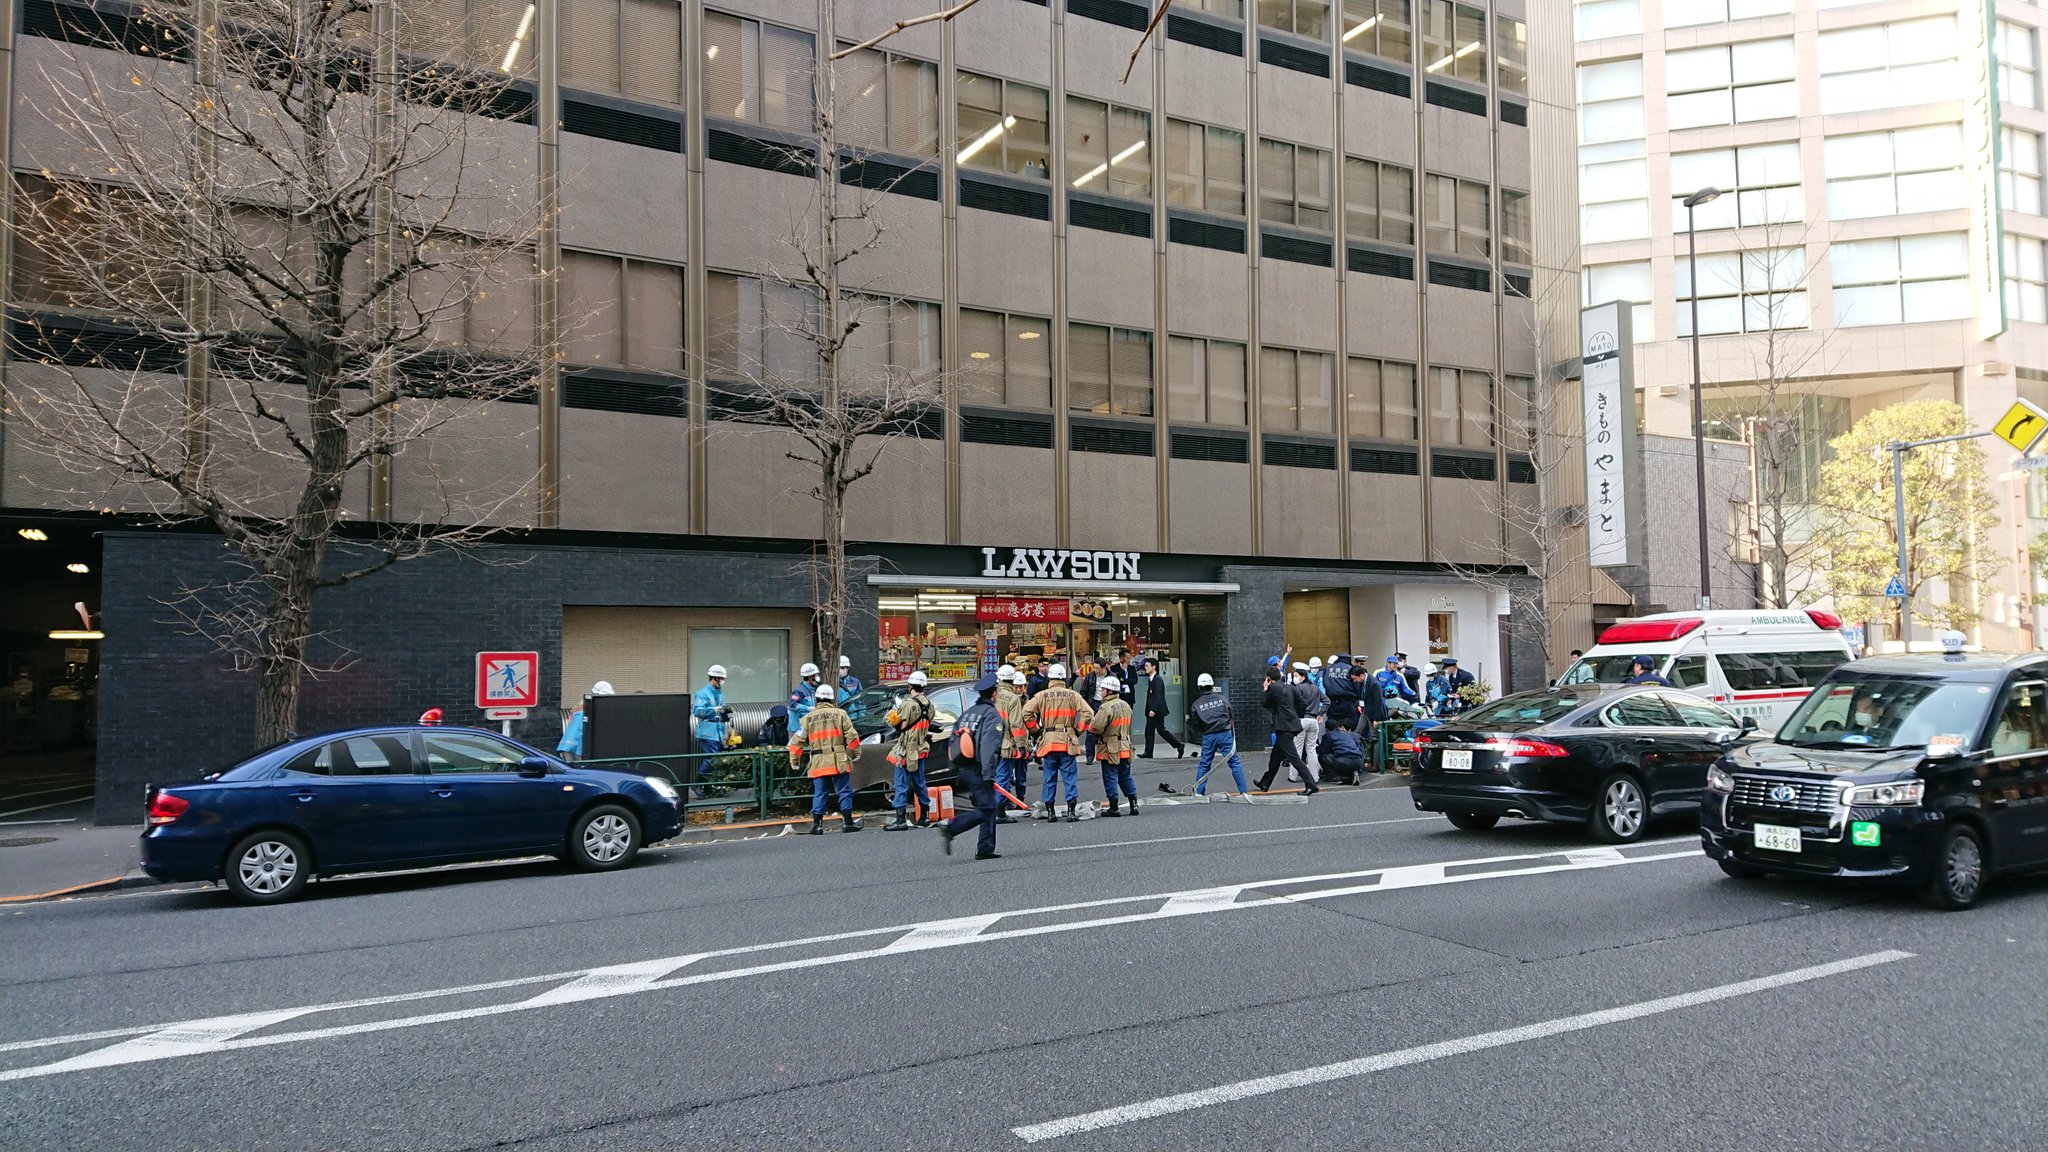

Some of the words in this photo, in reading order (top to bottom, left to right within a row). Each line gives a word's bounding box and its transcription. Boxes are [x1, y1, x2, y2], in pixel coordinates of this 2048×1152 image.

[1595, 334, 1606, 343] YA
[1590, 341, 1612, 352] MATO
[1597, 392, 1611, 444] きもの
[1593, 453, 1614, 532] やまと
[981, 547, 1141, 580] LAWSON
[1007, 601, 1045, 618] 恵方巻
[1751, 615, 1807, 624] AMBULANCE
[1448, 757, 1470, 768] 80-08
[1765, 835, 1798, 850] 68-60
